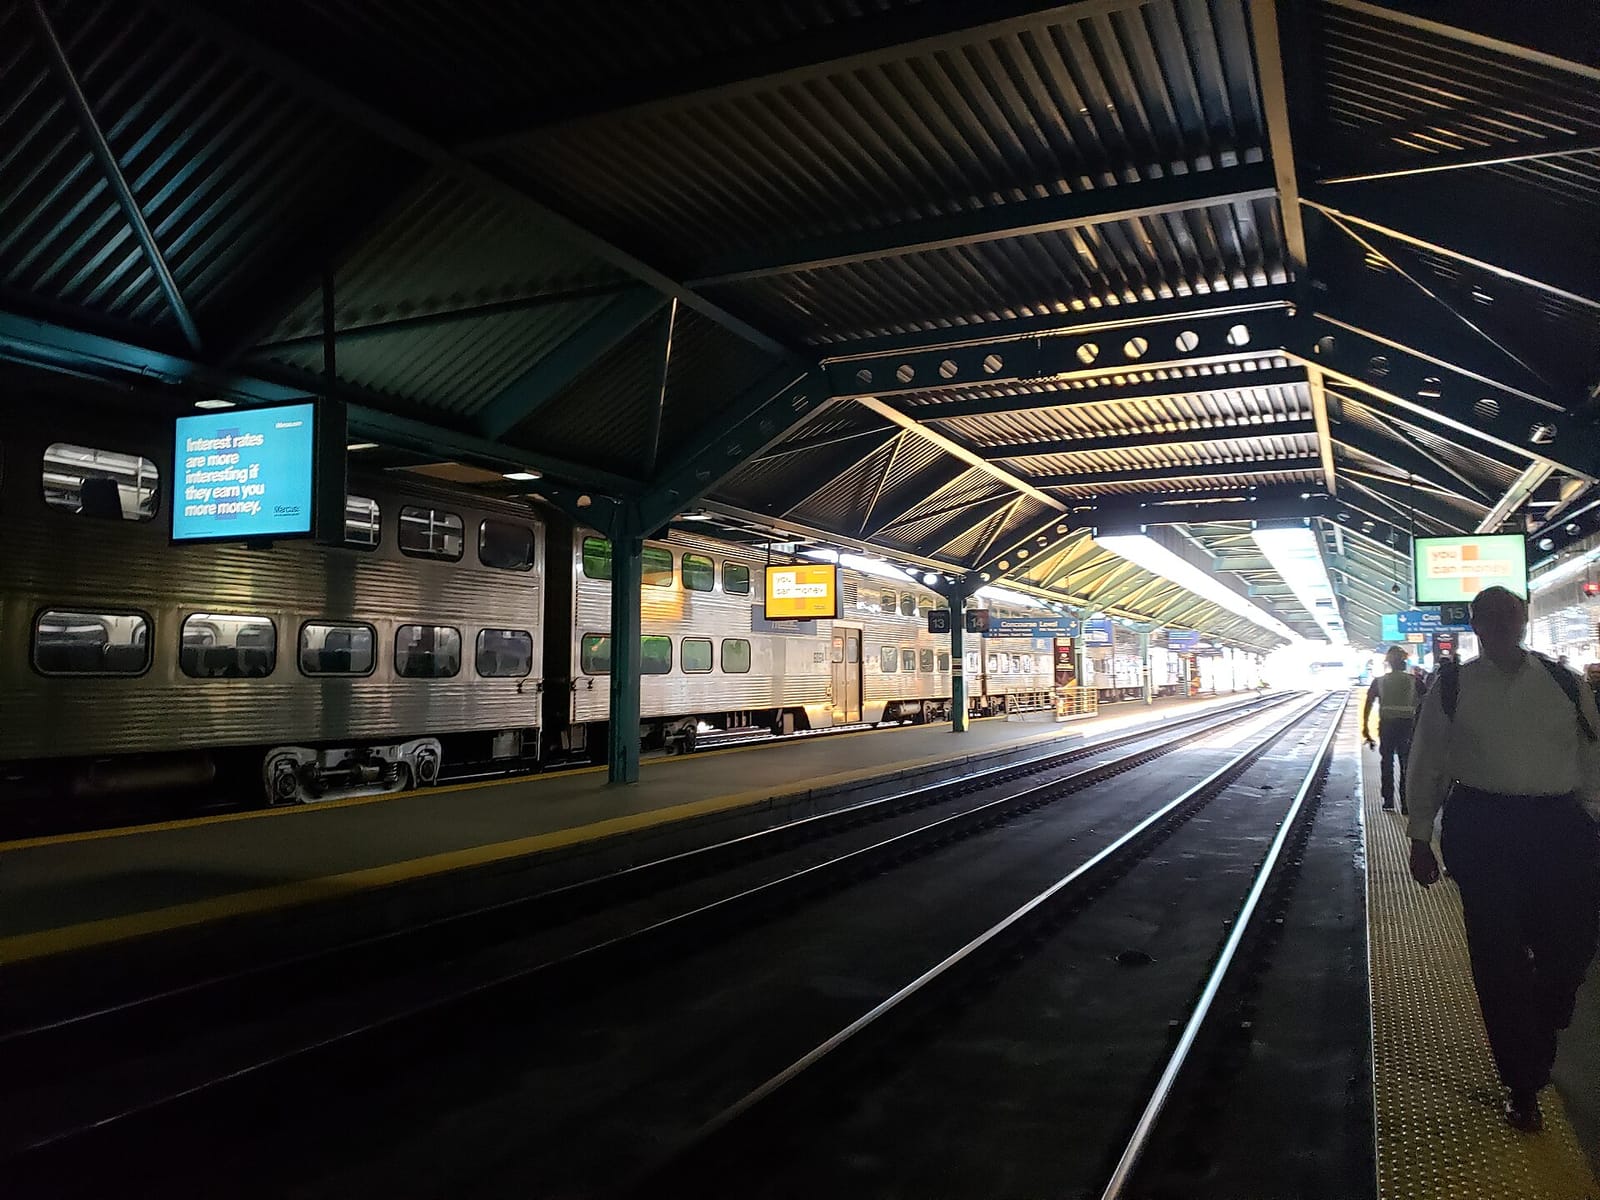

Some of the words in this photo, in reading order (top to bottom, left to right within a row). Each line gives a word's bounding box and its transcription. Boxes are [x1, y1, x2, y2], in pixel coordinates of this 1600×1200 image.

[186, 434, 231, 452] Interest
[232, 432, 264, 448] rates
[185, 455, 206, 468] are
[207, 453, 239, 466] more
[185, 465, 248, 484] interesting
[249, 463, 260, 479] if
[185, 485, 212, 502] they
[212, 485, 240, 498] earn
[241, 483, 265, 499] you
[184, 503, 217, 517] more
[217, 500, 261, 516] money.
[1432, 551, 1457, 561] you
[1432, 565, 1456, 574] can
[1446, 606, 1466, 620] 15
[932, 618, 945, 629] 13
[970, 617, 985, 628] 14
